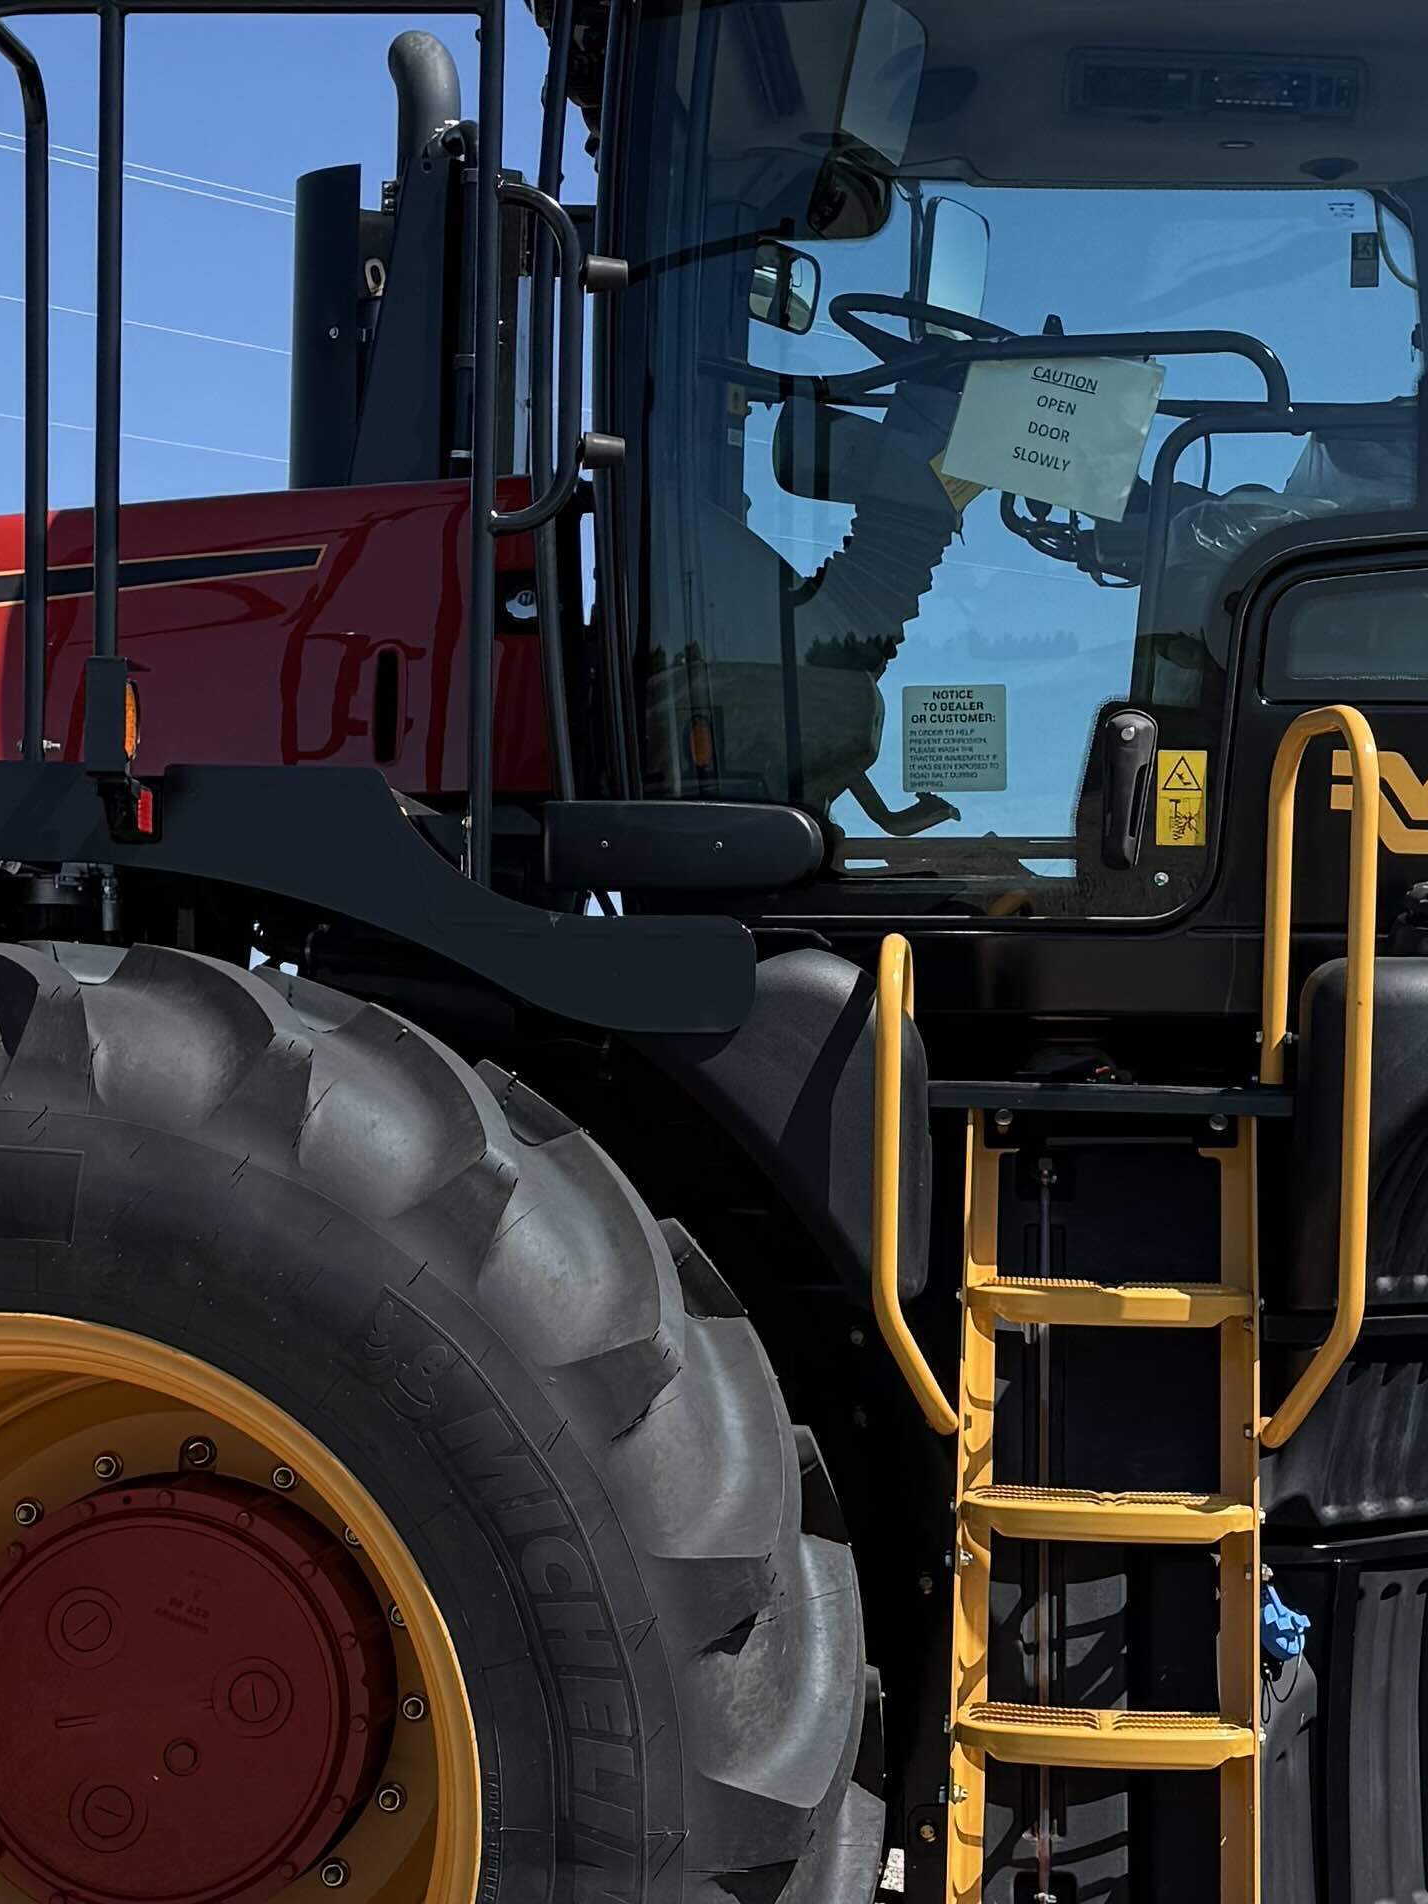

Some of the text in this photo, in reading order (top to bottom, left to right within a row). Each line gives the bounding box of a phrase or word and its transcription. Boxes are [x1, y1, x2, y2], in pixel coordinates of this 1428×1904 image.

[1032, 365, 1099, 393] CAUTION
[1036, 395, 1077, 416] OPEN
[1027, 421, 1071, 443] DOOR
[1012, 446, 1071, 472] SLOWLY
[932, 690, 974, 699] NOTICE
[923, 701, 984, 712] TO DEALER
[911, 713, 996, 723] OR CUSTOMER:
